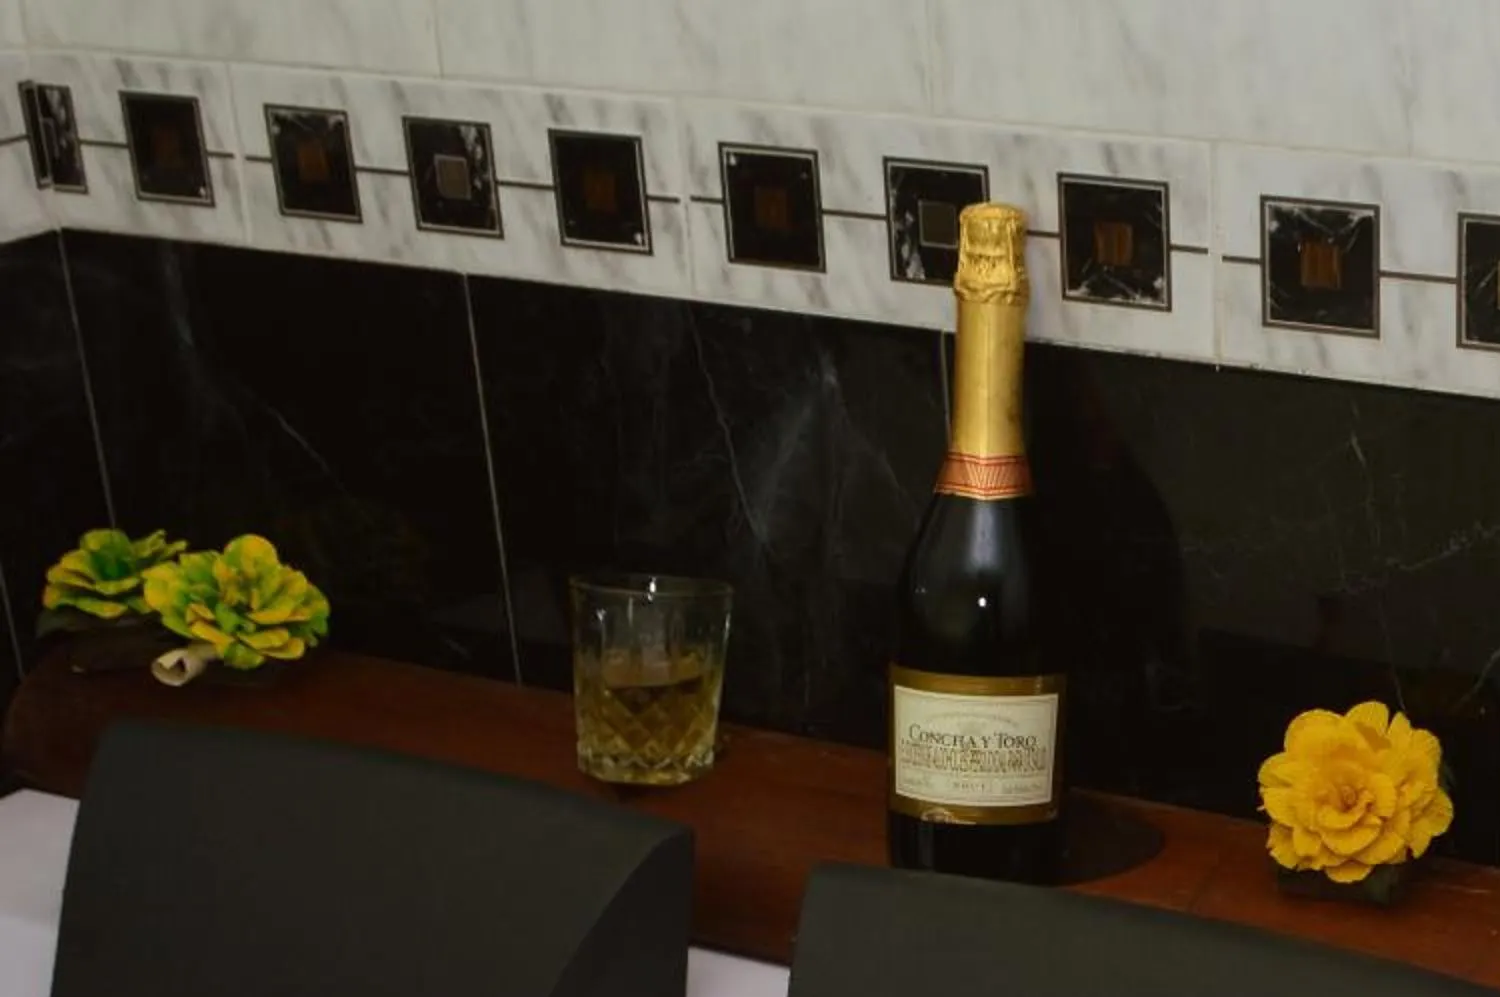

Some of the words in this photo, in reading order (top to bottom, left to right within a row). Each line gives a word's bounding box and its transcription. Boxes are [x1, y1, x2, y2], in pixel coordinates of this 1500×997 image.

[909, 723, 977, 748] CONCHA
[979, 735, 991, 748] Y
[994, 732, 1037, 749] TORO
